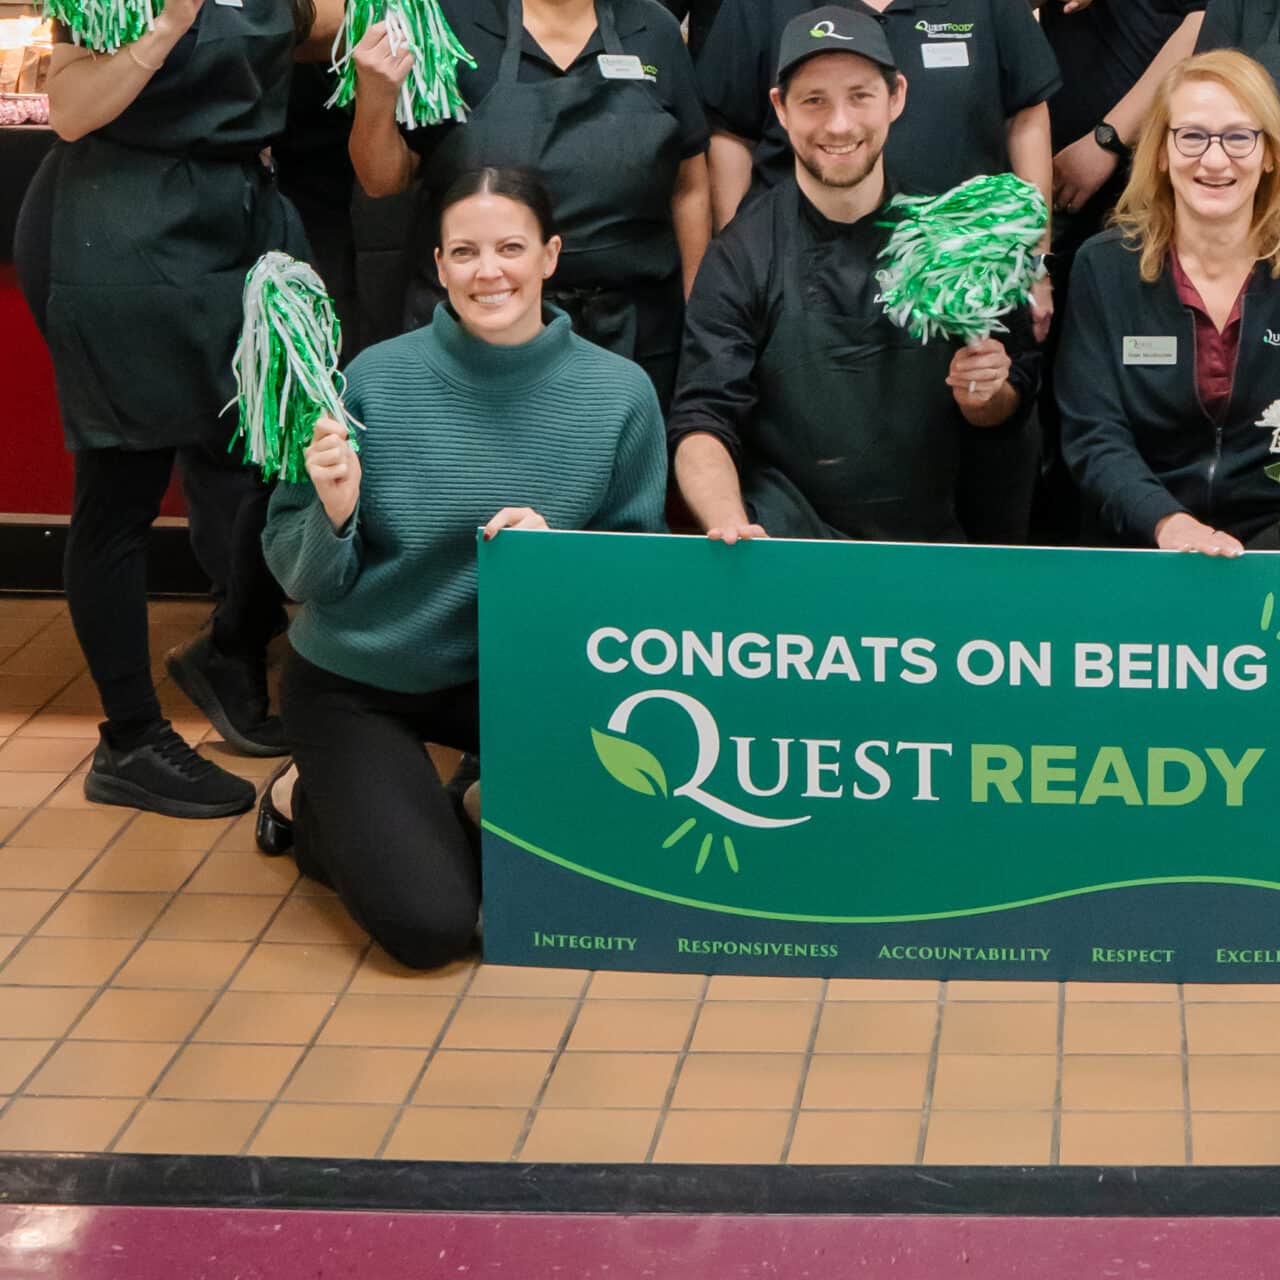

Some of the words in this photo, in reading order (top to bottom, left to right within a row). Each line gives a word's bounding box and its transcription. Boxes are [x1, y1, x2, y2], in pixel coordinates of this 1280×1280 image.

[915, 20, 974, 34] QUESTFOOD
[586, 626, 938, 685] CONGRATS
[956, 639, 1052, 687] ON
[1074, 642, 1268, 691] BEING
[606, 689, 953, 829] QUEST
[970, 743, 1266, 807] READY
[533, 931, 637, 952] INTEGRITY
[677, 937, 839, 959] RESPONSIVENESS
[878, 943, 1051, 962] ACCOUNTABILITY
[1091, 946, 1175, 964] RESPECT
